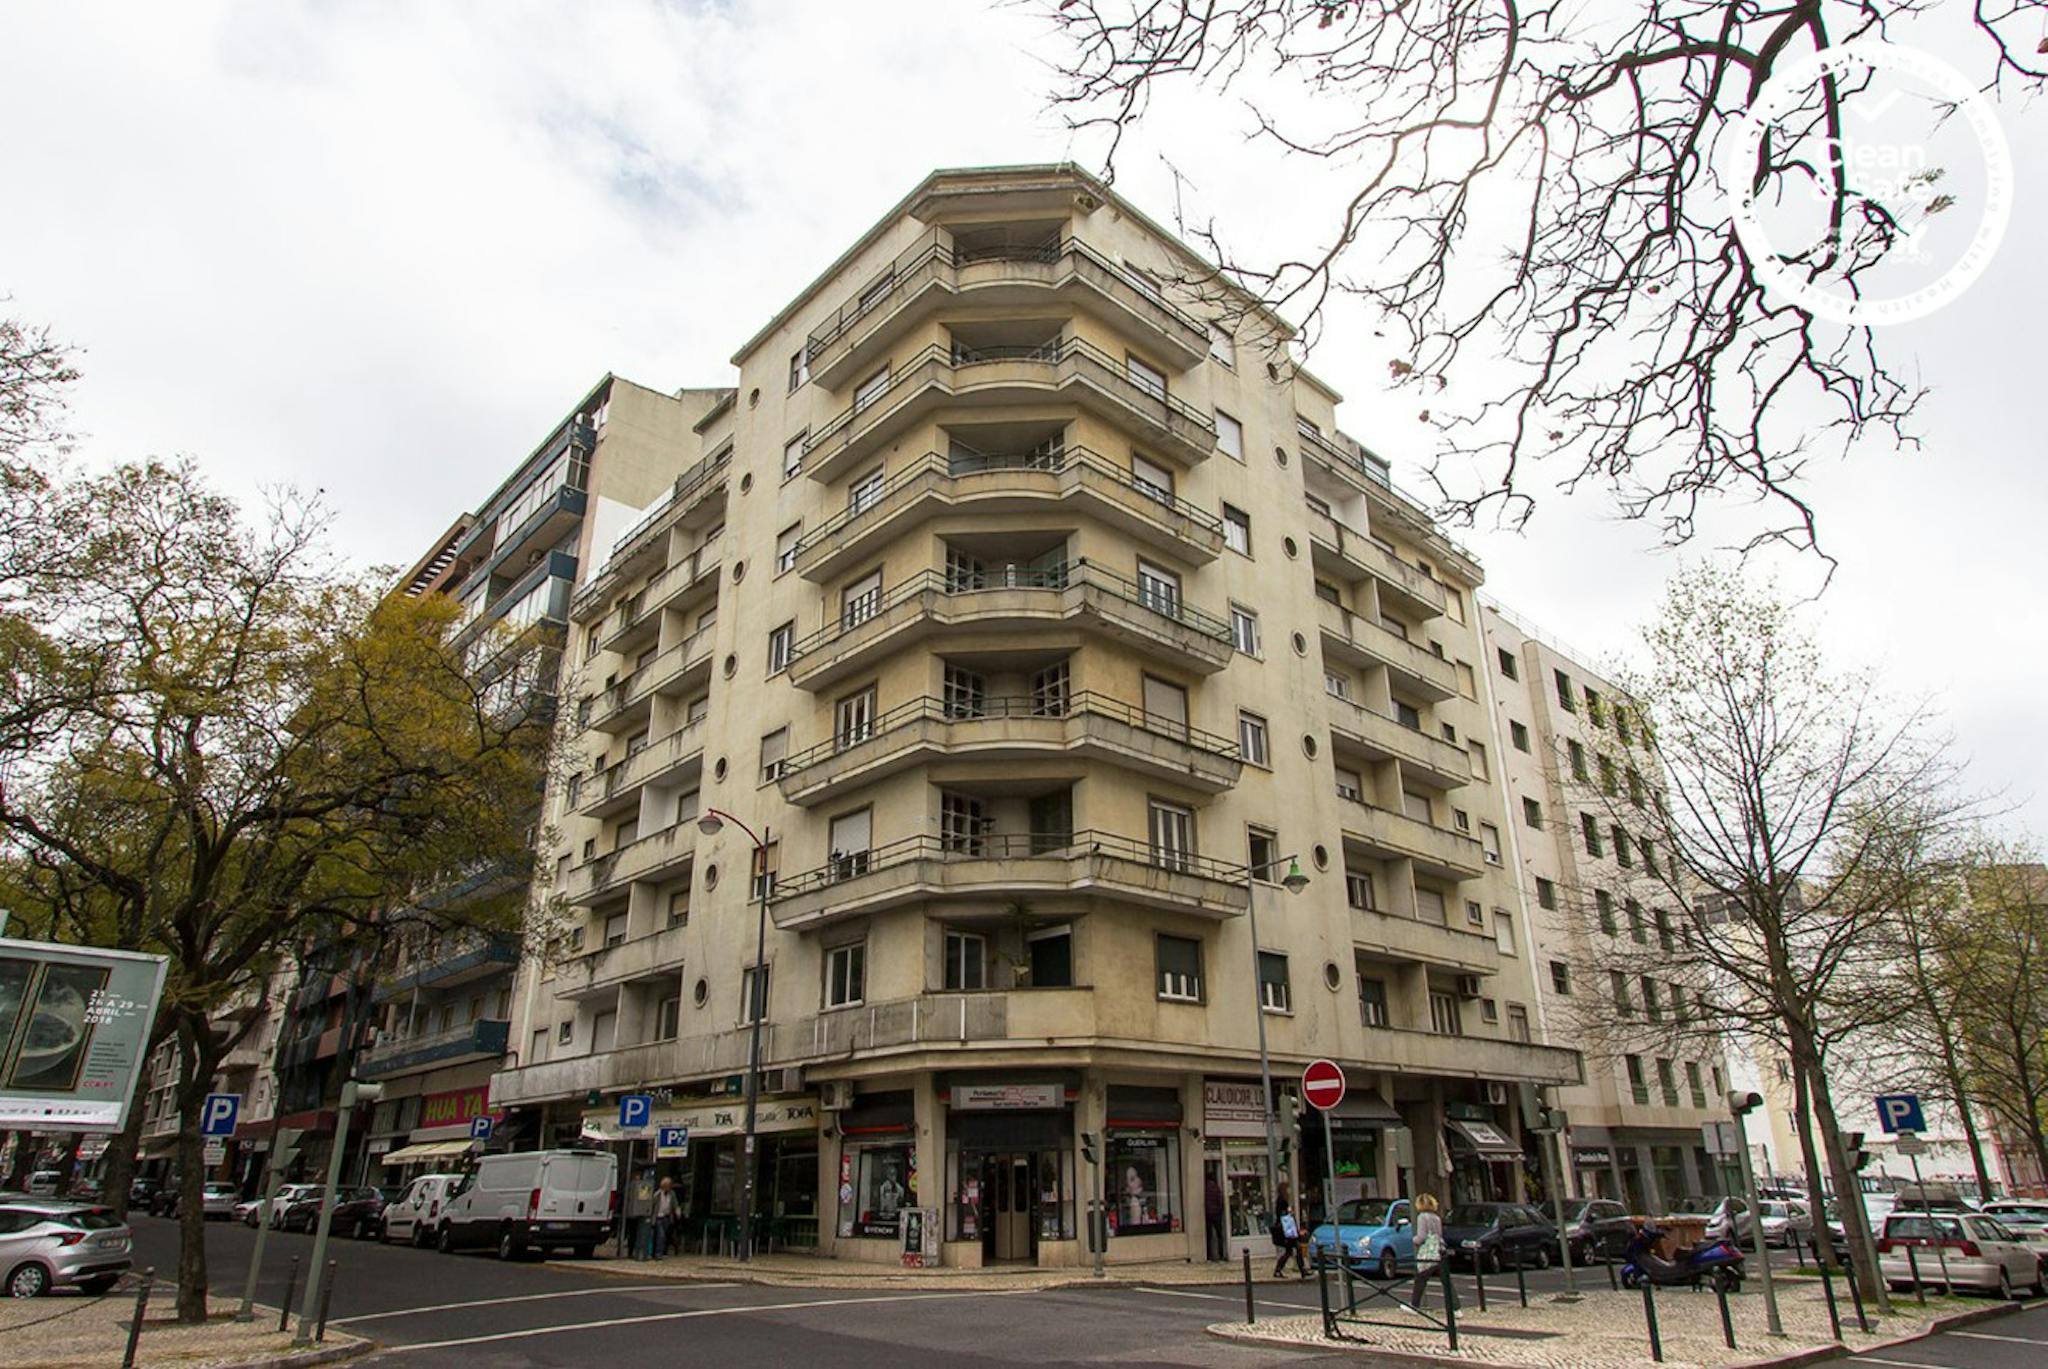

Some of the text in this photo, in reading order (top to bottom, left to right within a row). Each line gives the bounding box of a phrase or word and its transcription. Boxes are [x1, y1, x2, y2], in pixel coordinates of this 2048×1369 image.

[86, 1007, 121, 1017] ABRIL
[206, 1098, 233, 1132] P
[425, 1094, 482, 1121] HUA TA
[625, 1099, 644, 1124] P
[1886, 1100, 1911, 1128] P
[473, 1119, 489, 1135] P
